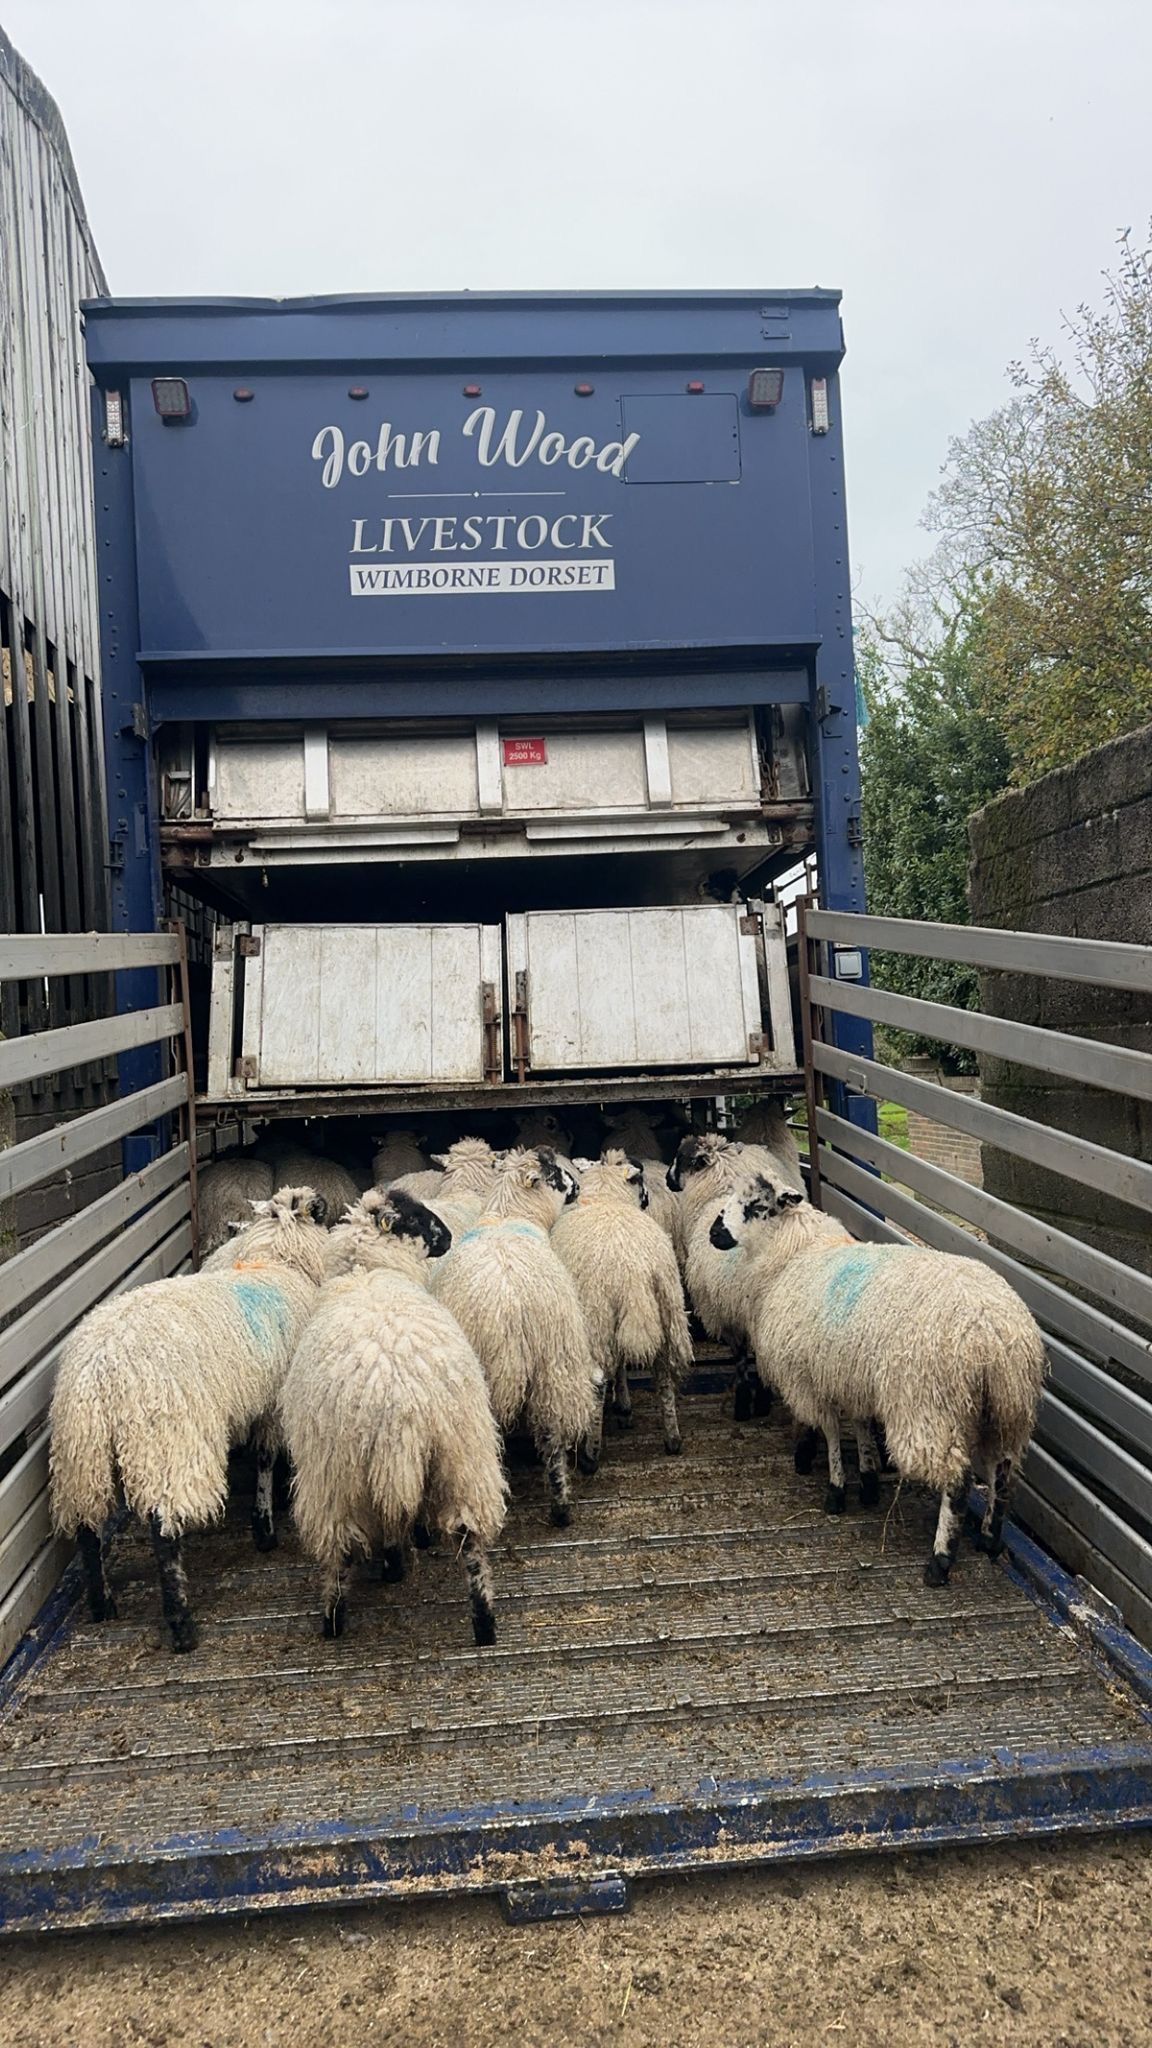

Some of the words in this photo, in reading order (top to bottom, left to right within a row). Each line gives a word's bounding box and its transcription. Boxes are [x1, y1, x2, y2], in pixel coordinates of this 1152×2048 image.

[312, 423, 440, 489] John
[462, 406, 641, 477] Wood
[349, 514, 614, 553] LIVESTOCK
[356, 567, 500, 590] WIMBORNE
[510, 565, 609, 587] DORSET
[509, 752, 528, 760] 2500
[530, 752, 541, 760] Kg
[515, 742, 534, 750] SWL
